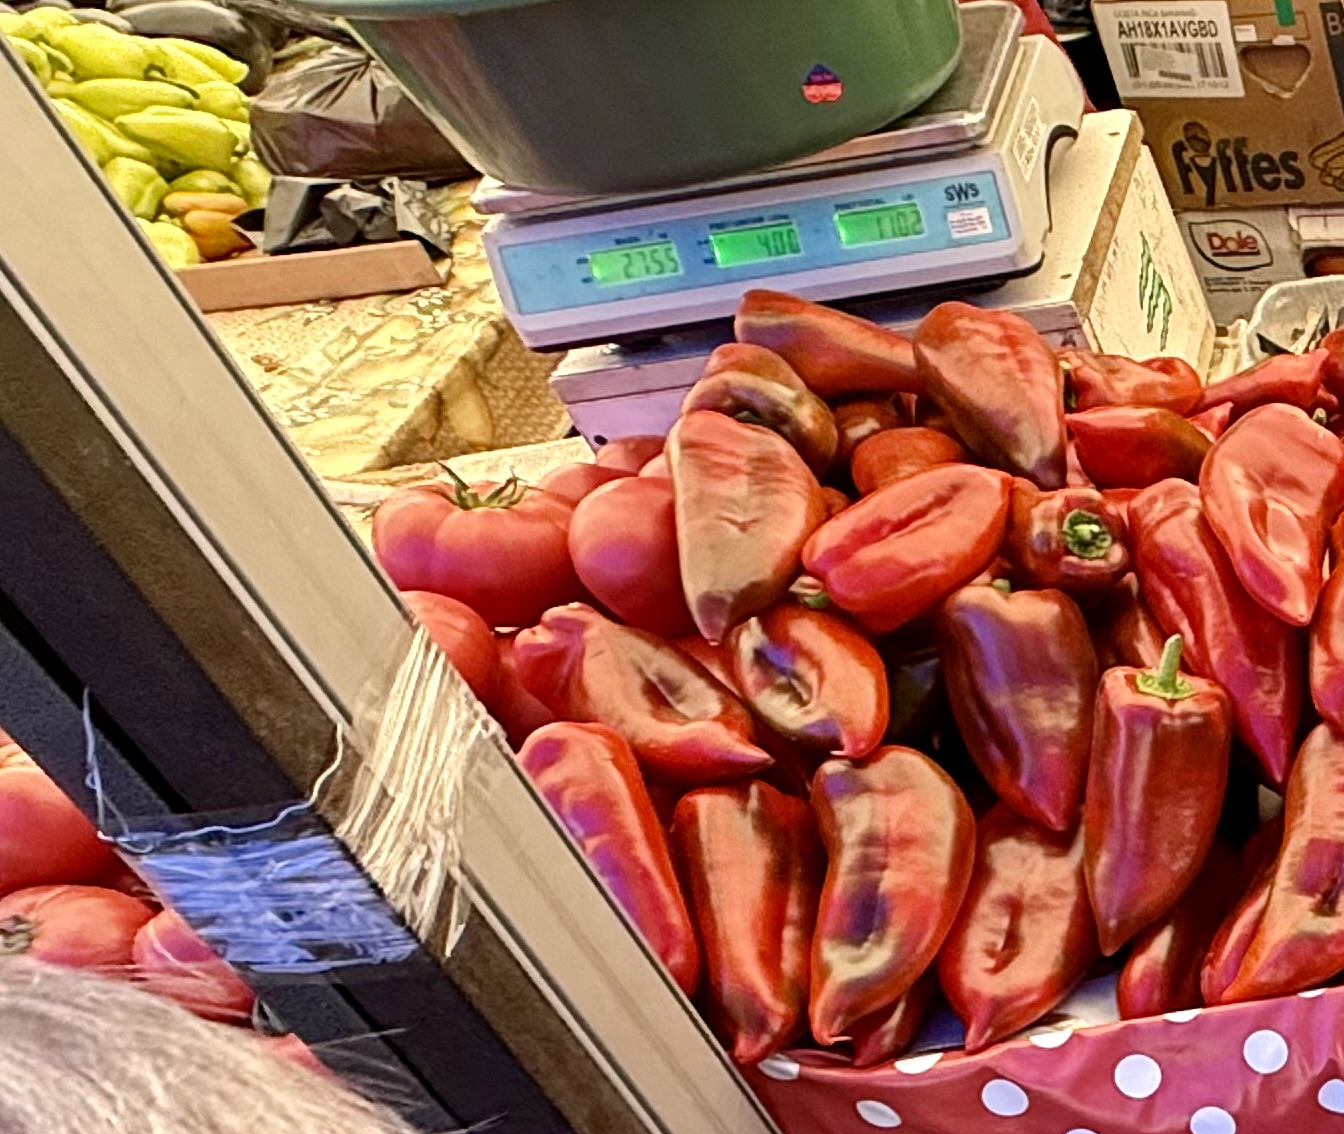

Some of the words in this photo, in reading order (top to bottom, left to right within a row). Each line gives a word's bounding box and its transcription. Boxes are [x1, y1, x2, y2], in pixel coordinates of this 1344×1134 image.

[1171, 132, 1305, 206] fyffes
[944, 183, 980, 202] SWS
[1206, 230, 1258, 250] Dole
